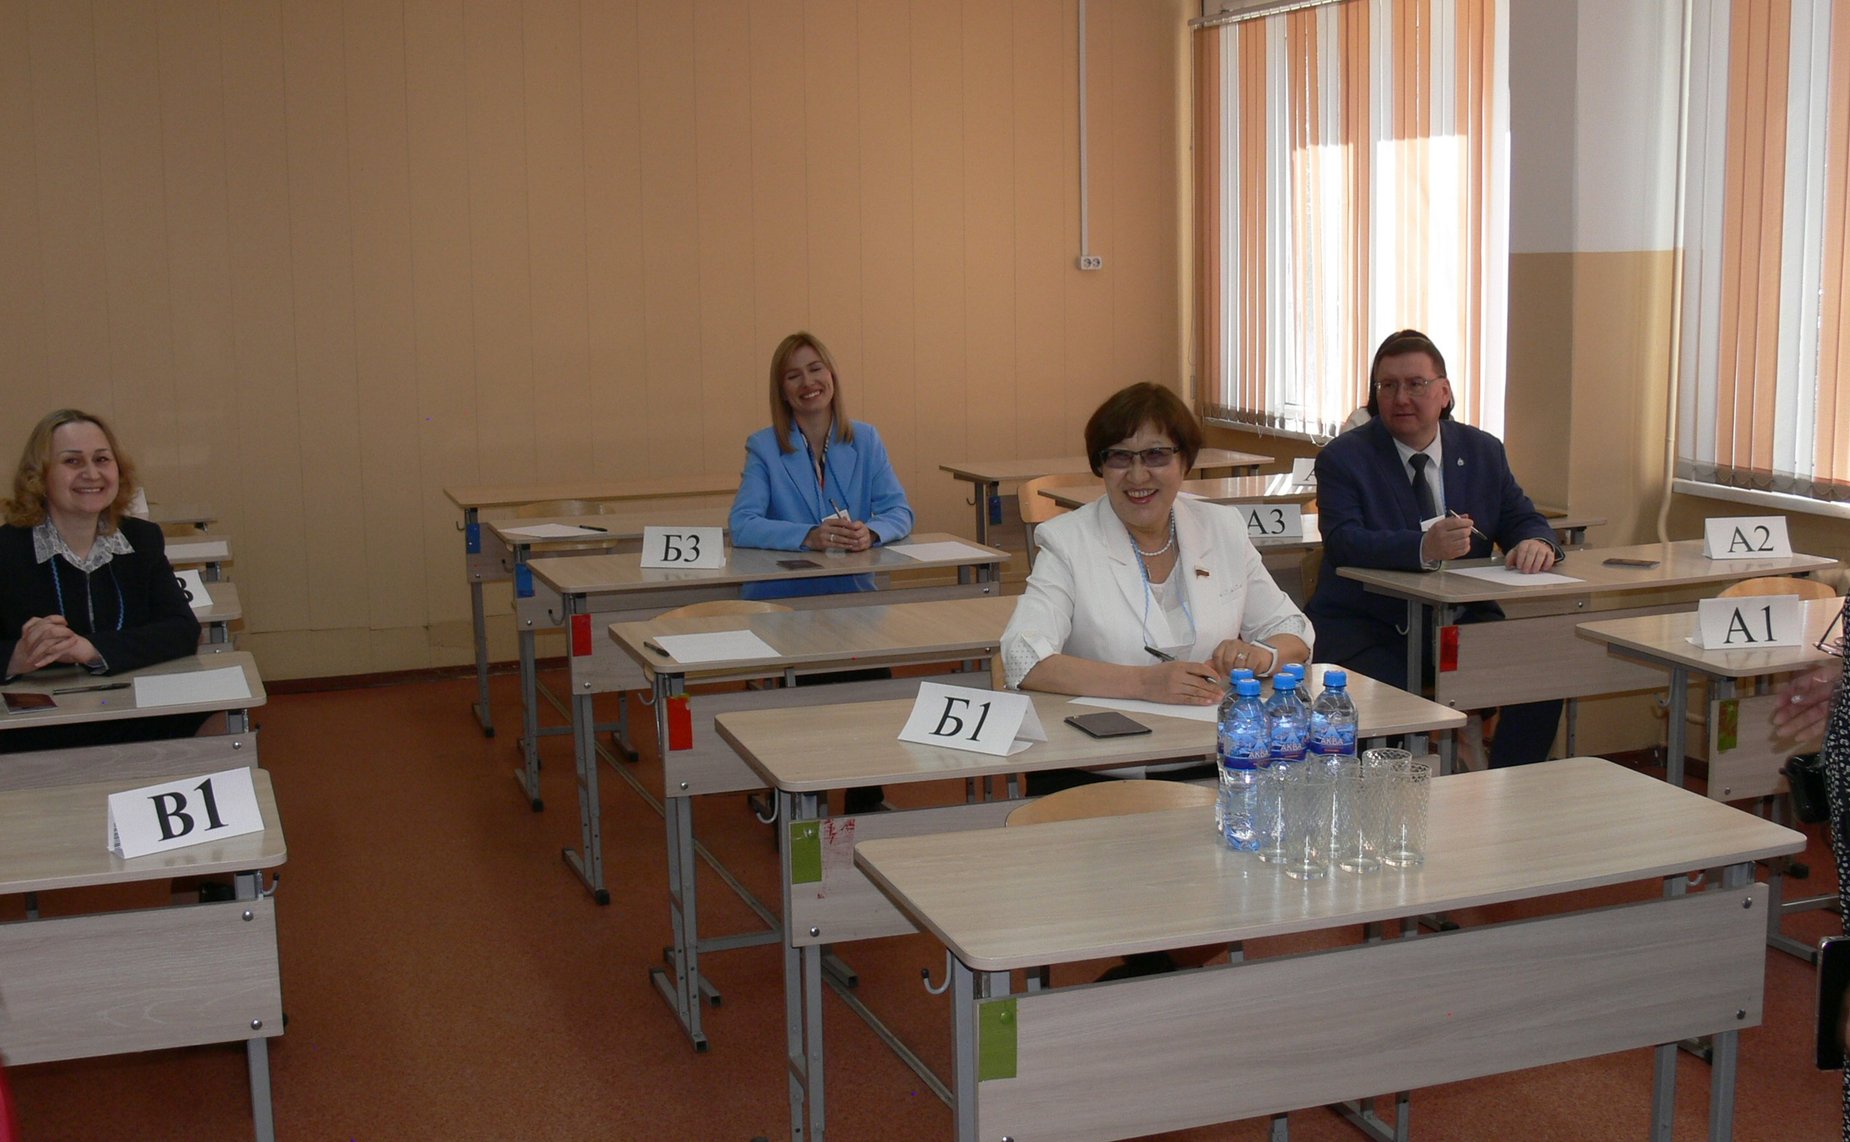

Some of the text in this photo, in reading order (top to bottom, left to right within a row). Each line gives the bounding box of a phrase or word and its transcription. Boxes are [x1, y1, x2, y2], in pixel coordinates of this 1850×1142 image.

[1247, 508, 1285, 534] А3
[660, 534, 700, 562] Б3
[1727, 525, 1774, 553] А2
[1723, 605, 1777, 644] А1
[928, 696, 992, 742] Б1
[147, 778, 229, 842] В1
